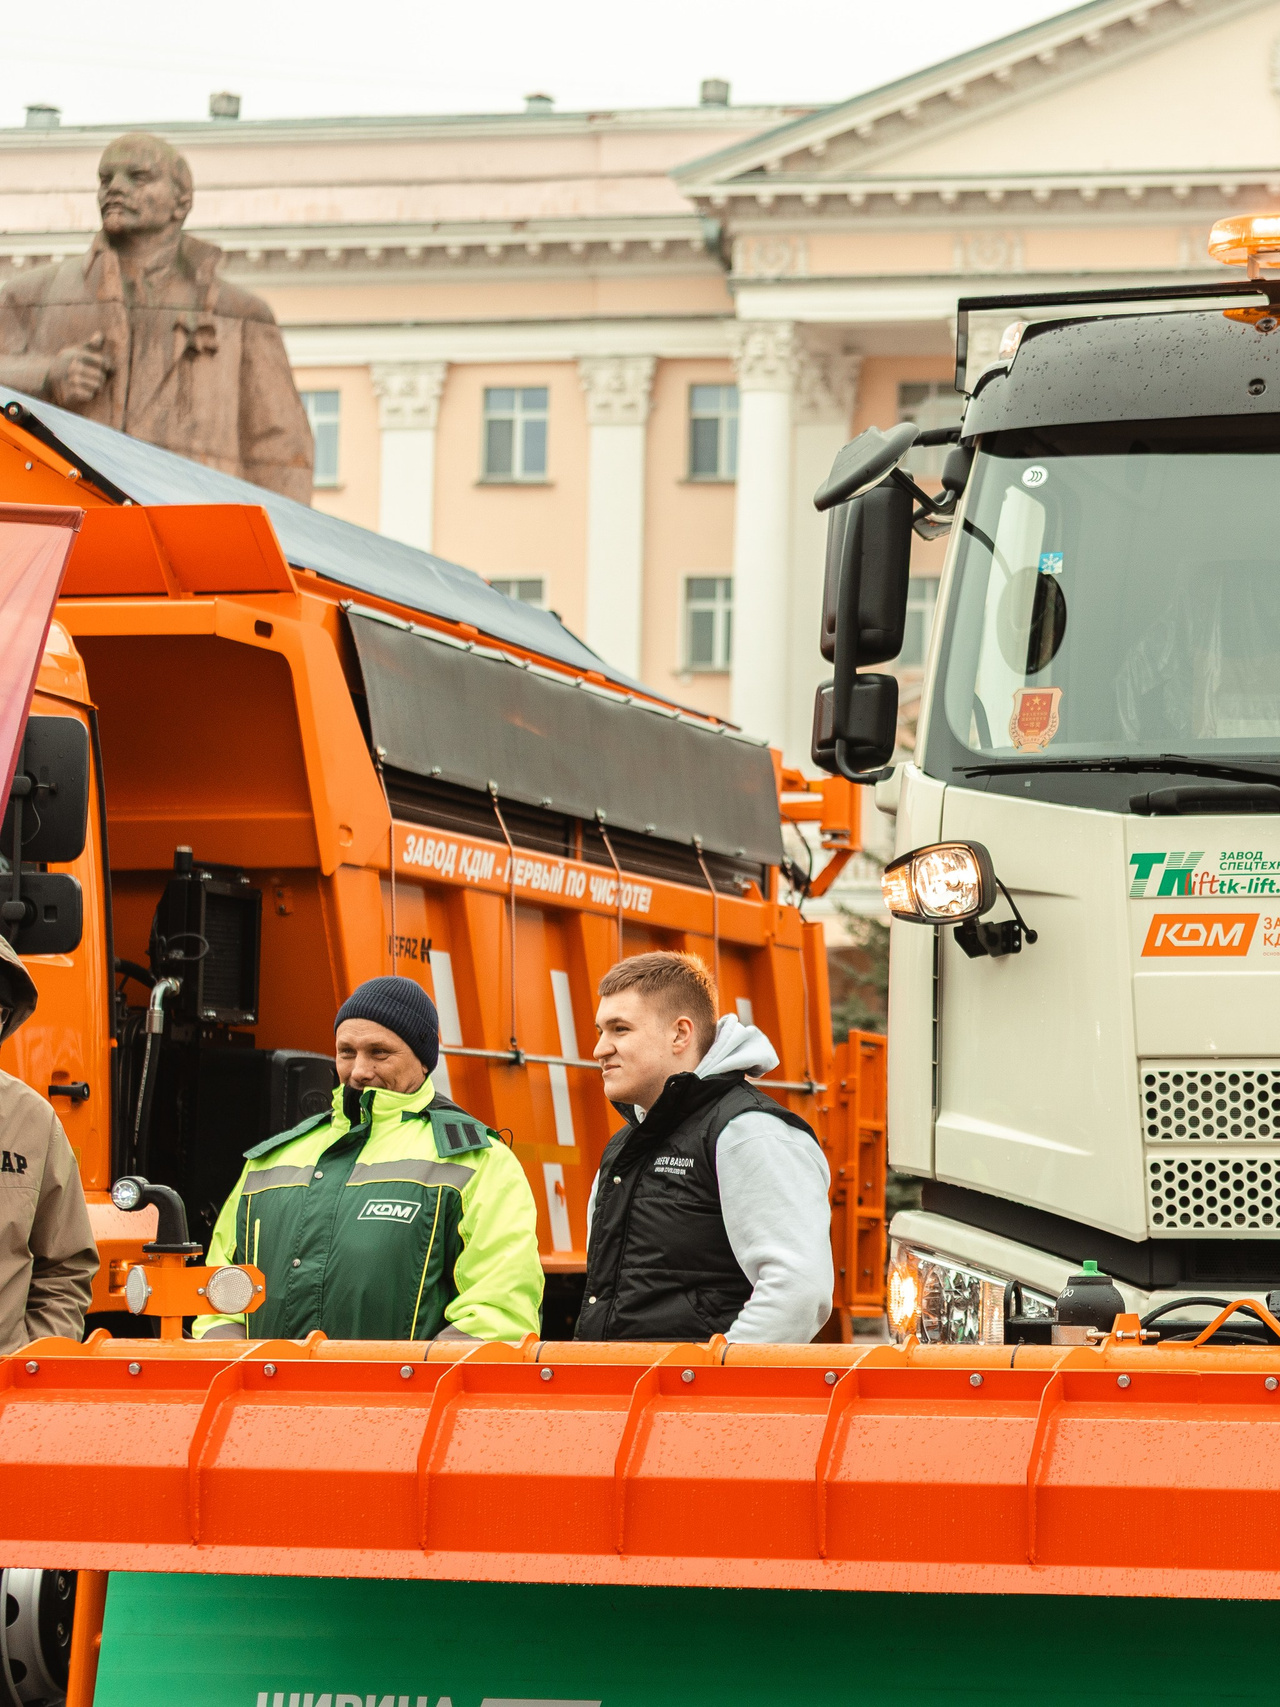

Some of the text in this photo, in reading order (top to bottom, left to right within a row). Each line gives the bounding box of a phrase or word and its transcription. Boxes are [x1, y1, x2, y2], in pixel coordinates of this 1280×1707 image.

[1219, 851, 1263, 861] ЗАВОД
[403, 834, 457, 878] ЗАВОД
[458, 848, 496, 884] КДМ
[503, 856, 566, 895] ПЕРВЫЙ
[565, 869, 587, 899] ПО
[1154, 923, 1246, 947] KDM
[366, 1203, 413, 1218] KDM
